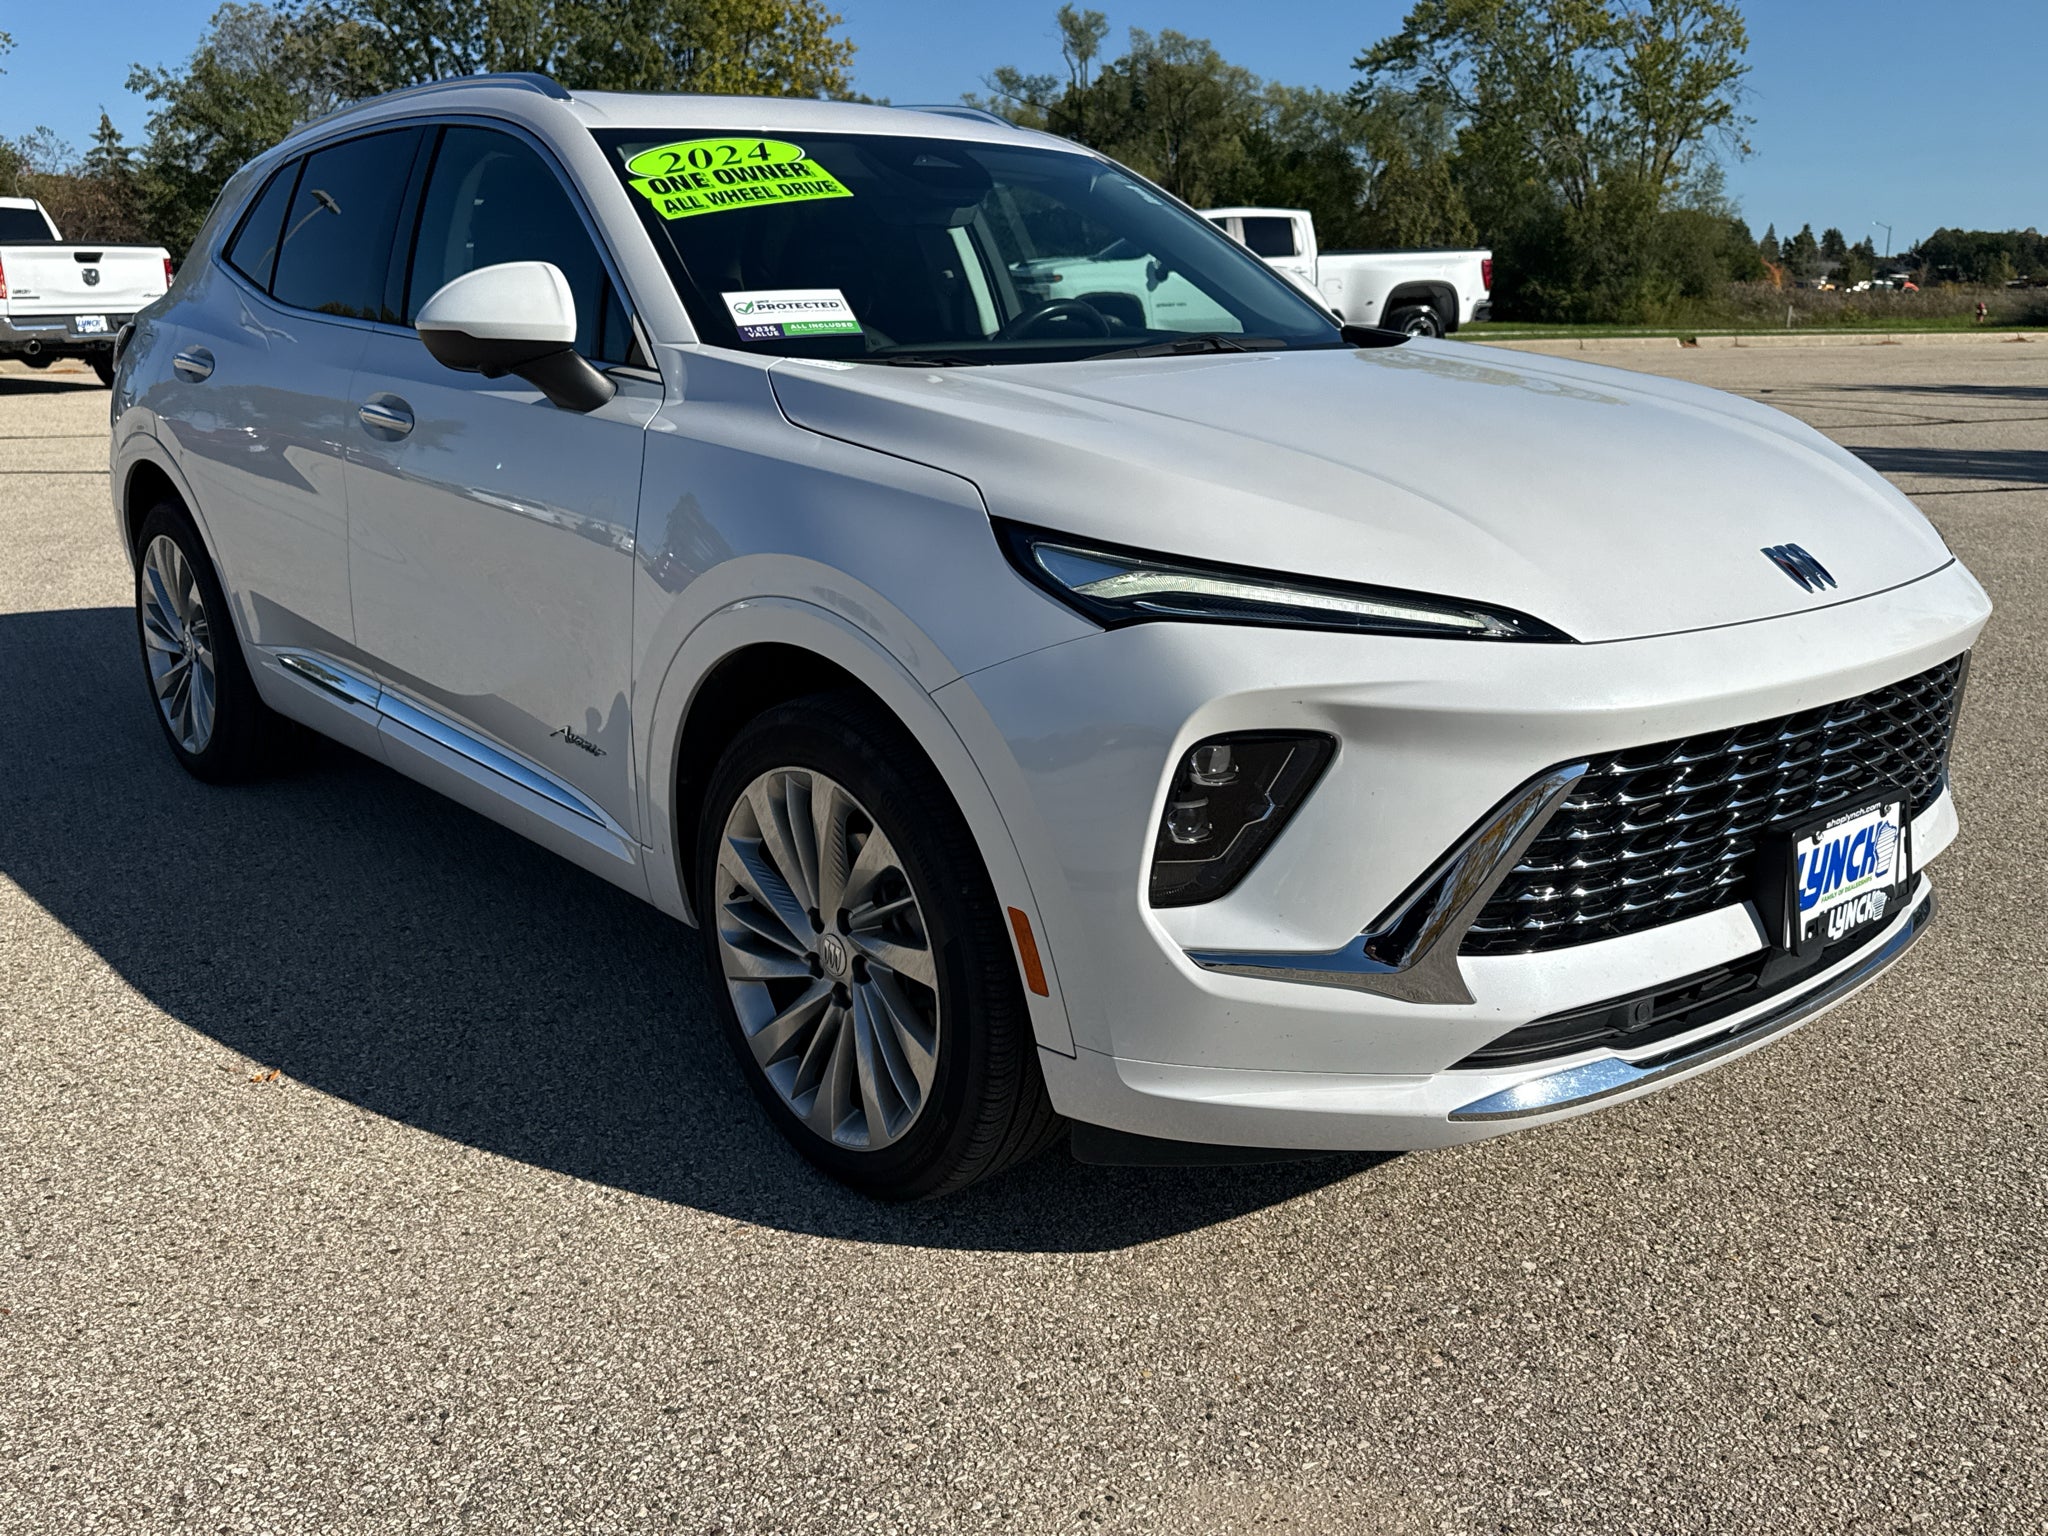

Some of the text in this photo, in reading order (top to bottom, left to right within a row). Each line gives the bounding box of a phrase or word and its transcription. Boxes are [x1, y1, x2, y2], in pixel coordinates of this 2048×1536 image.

[659, 142, 772, 174] 2024
[648, 161, 812, 195] ONE OWNER
[664, 180, 836, 214] ALL WHEEL DRIVE
[756, 301, 840, 311] PROTECTED
[747, 330, 780, 338] VALUE
[1826, 802, 1882, 829] shoplynch.com
[1828, 891, 1874, 941] LYNCH
